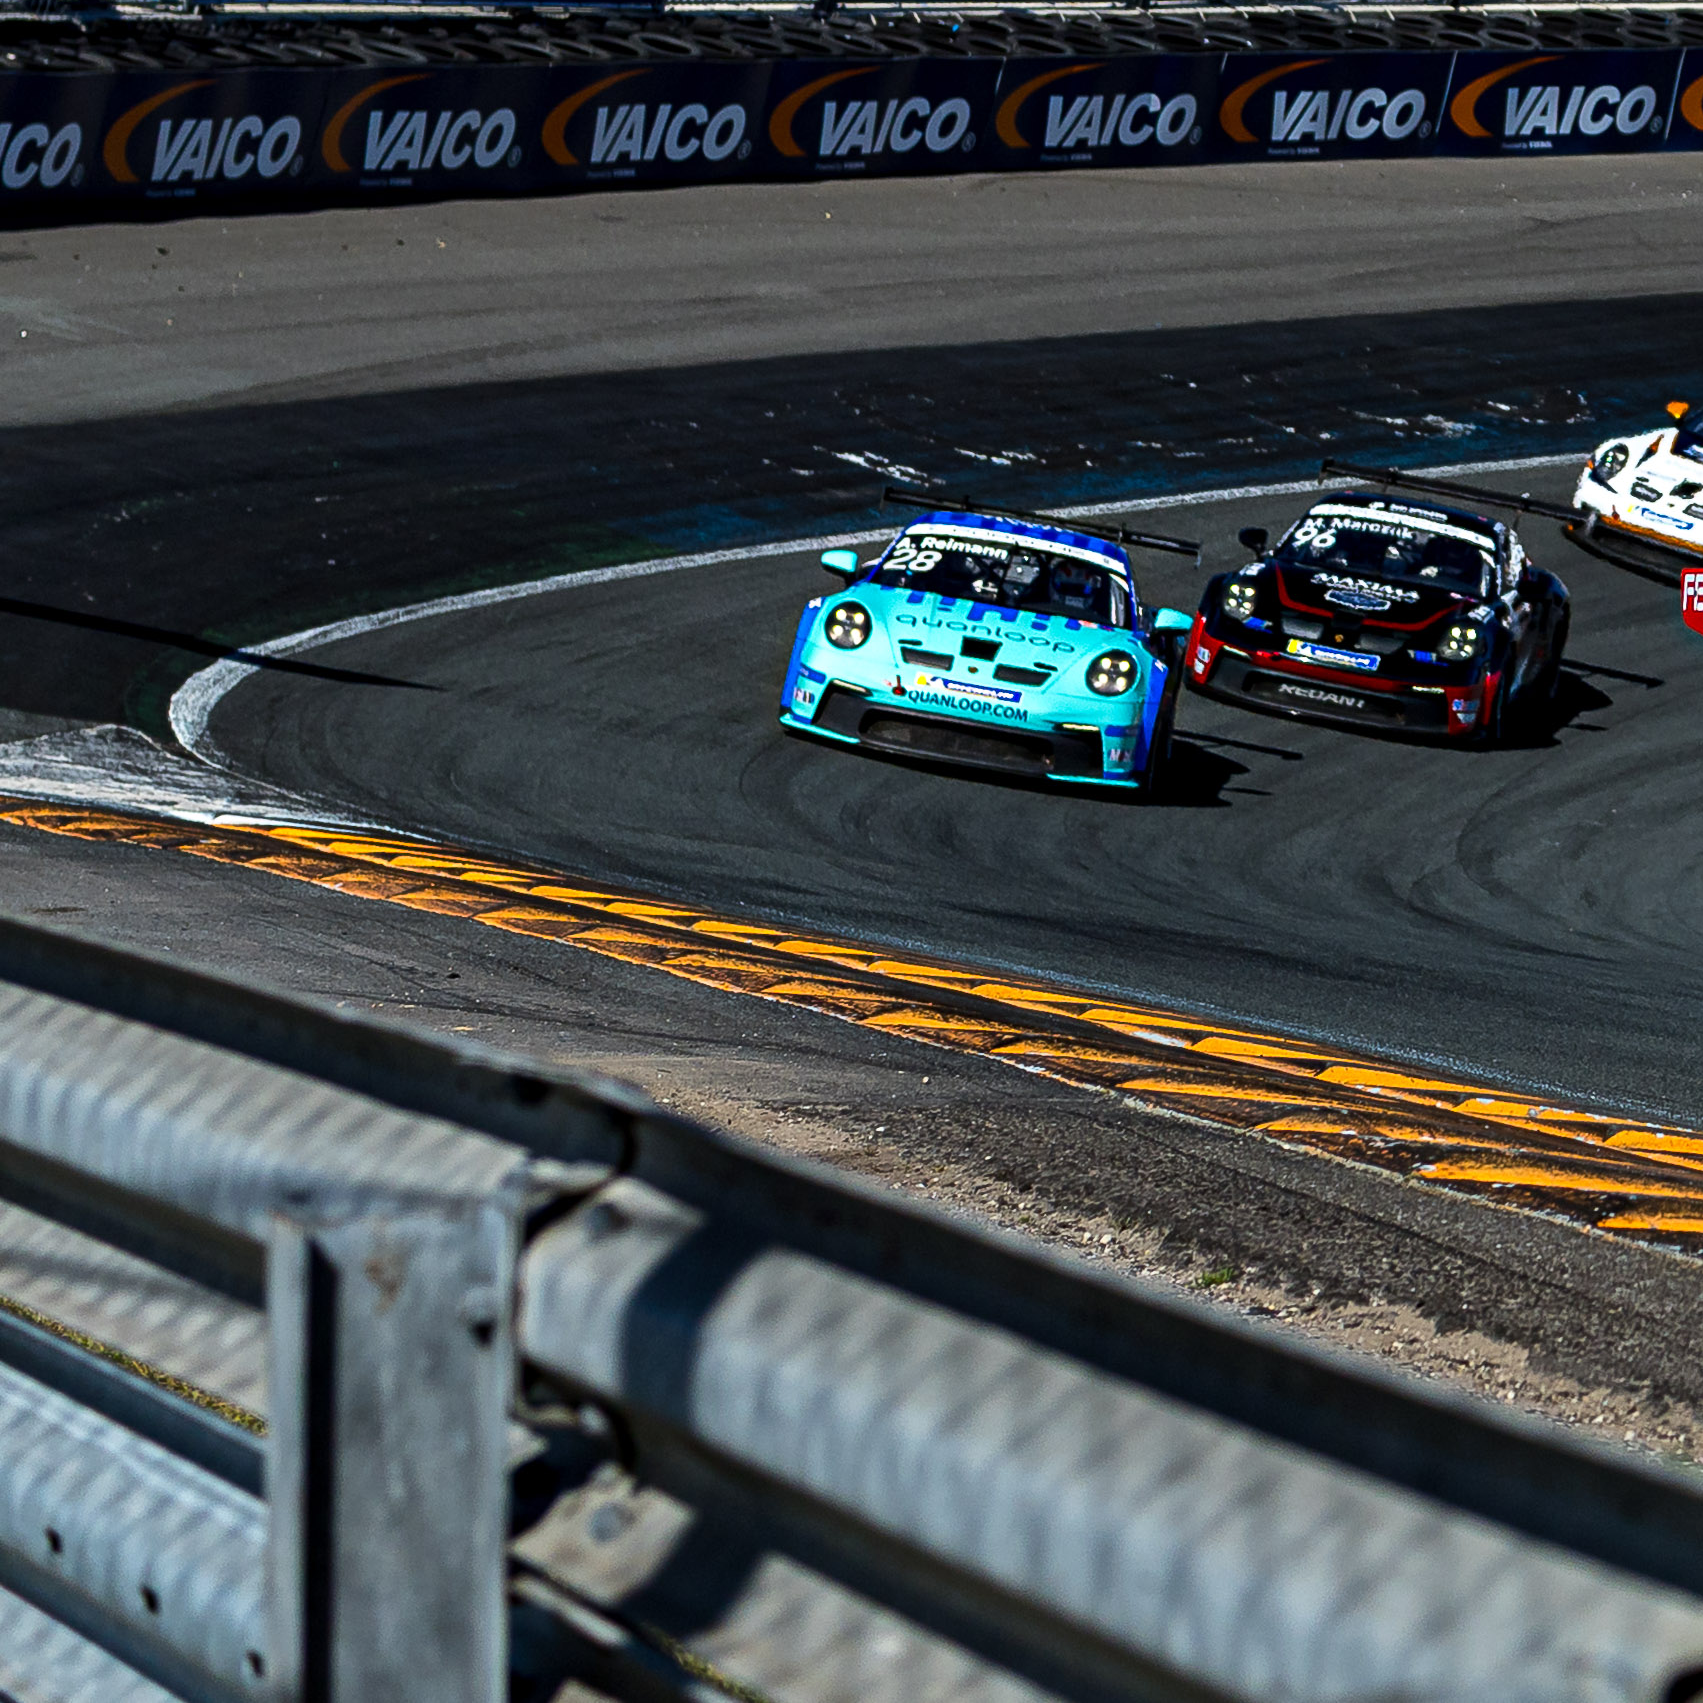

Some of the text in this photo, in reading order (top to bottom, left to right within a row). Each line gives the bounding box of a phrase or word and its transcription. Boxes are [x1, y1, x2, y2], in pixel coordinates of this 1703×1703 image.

[590, 103, 748, 165] VAICO
[819, 98, 972, 157] VAICO
[1044, 93, 1197, 148] VAICO
[1270, 88, 1426, 142] VAICO
[1504, 84, 1657, 136] VAICO
[150, 115, 302, 183] VAICO
[364, 108, 516, 171] VAICO
[883, 550, 943, 572] 28
[920, 537, 1010, 561] Reimann
[1293, 526, 1337, 549] 96
[895, 613, 1076, 653] quanloop
[907, 690, 1029, 723] QUANLOOP.COM
